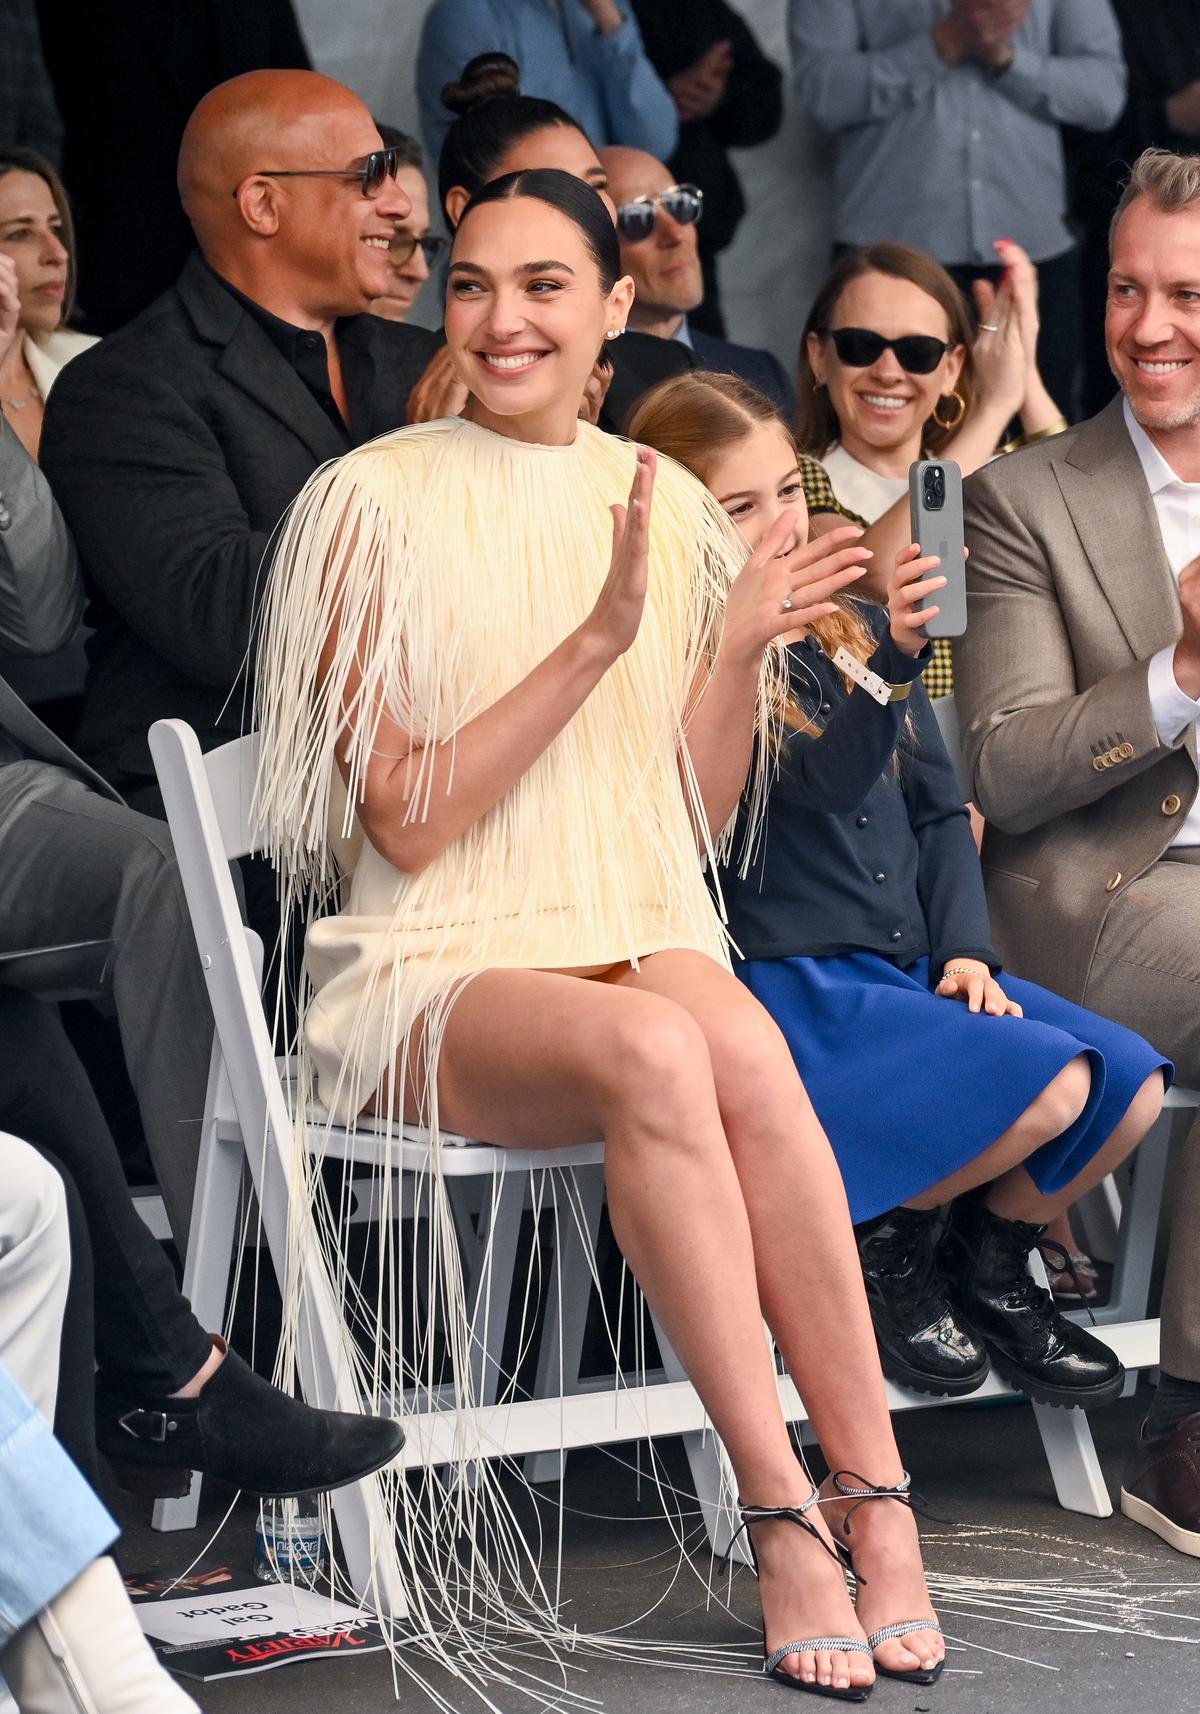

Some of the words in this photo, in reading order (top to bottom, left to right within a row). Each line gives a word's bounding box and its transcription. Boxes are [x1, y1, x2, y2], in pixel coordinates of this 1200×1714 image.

[176, 1602, 269, 1619] Gadot
[221, 1614, 273, 1627] Gal
[288, 1619, 381, 1639] VIDEO
[223, 1632, 366, 1664] VARIETY
